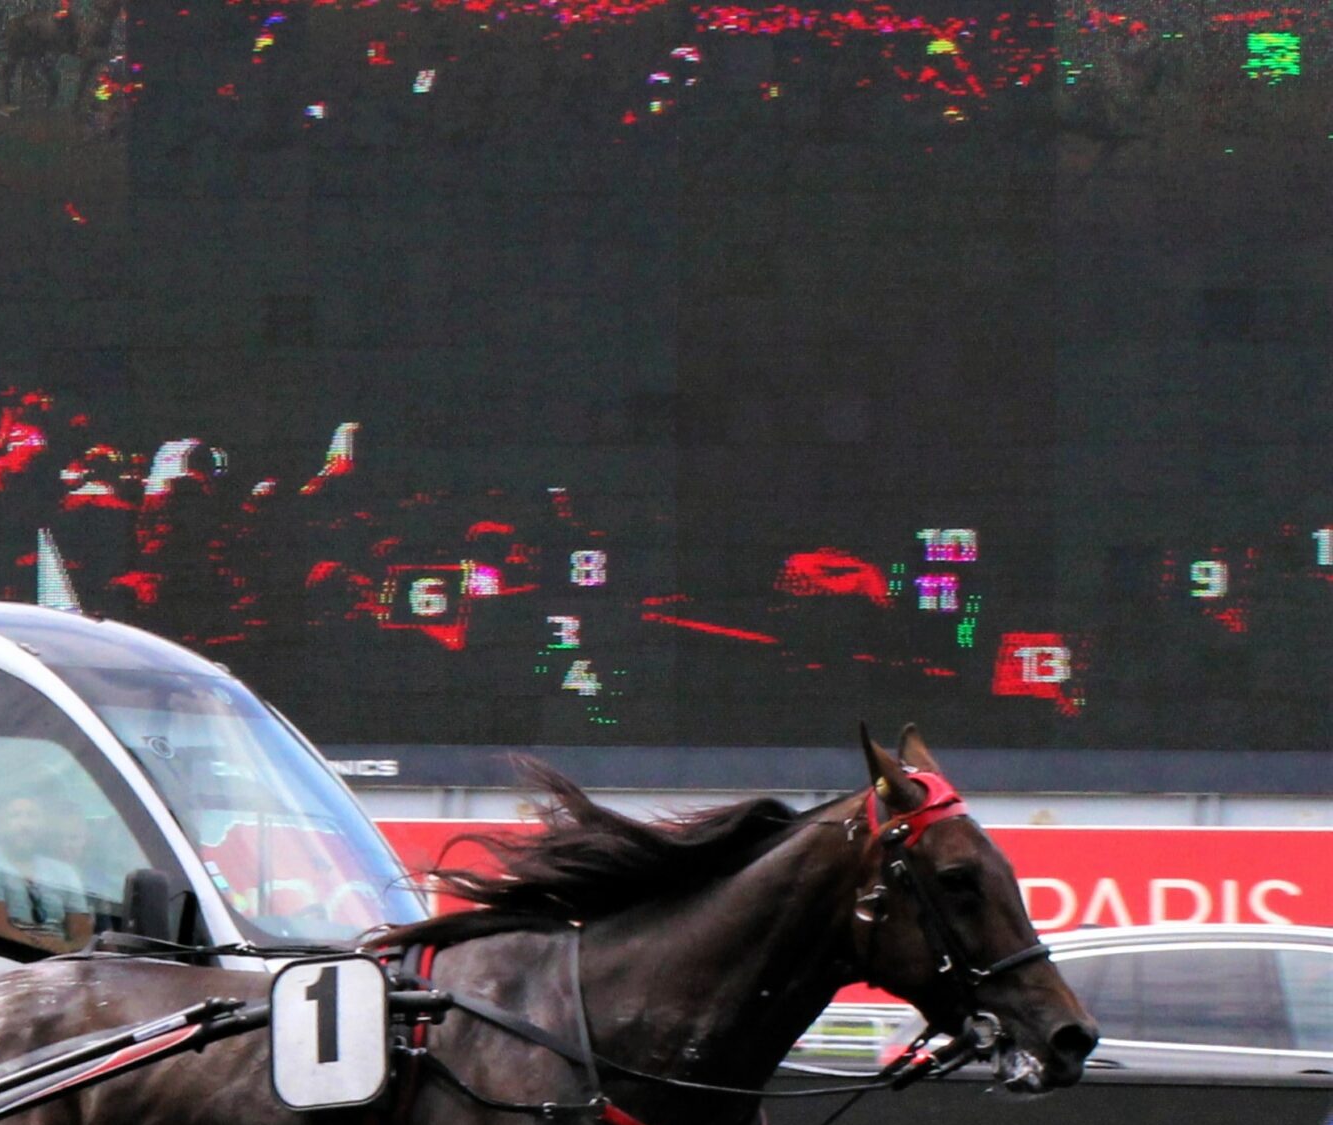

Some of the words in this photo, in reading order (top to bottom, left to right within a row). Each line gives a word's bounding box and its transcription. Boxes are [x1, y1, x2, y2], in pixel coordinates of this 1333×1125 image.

[569, 550, 607, 587] 8
[1190, 560, 1228, 598] 9
[409, 577, 448, 616] 6
[561, 660, 601, 696] 4
[1013, 646, 1071, 683] 13
[305, 966, 340, 1064] 1
